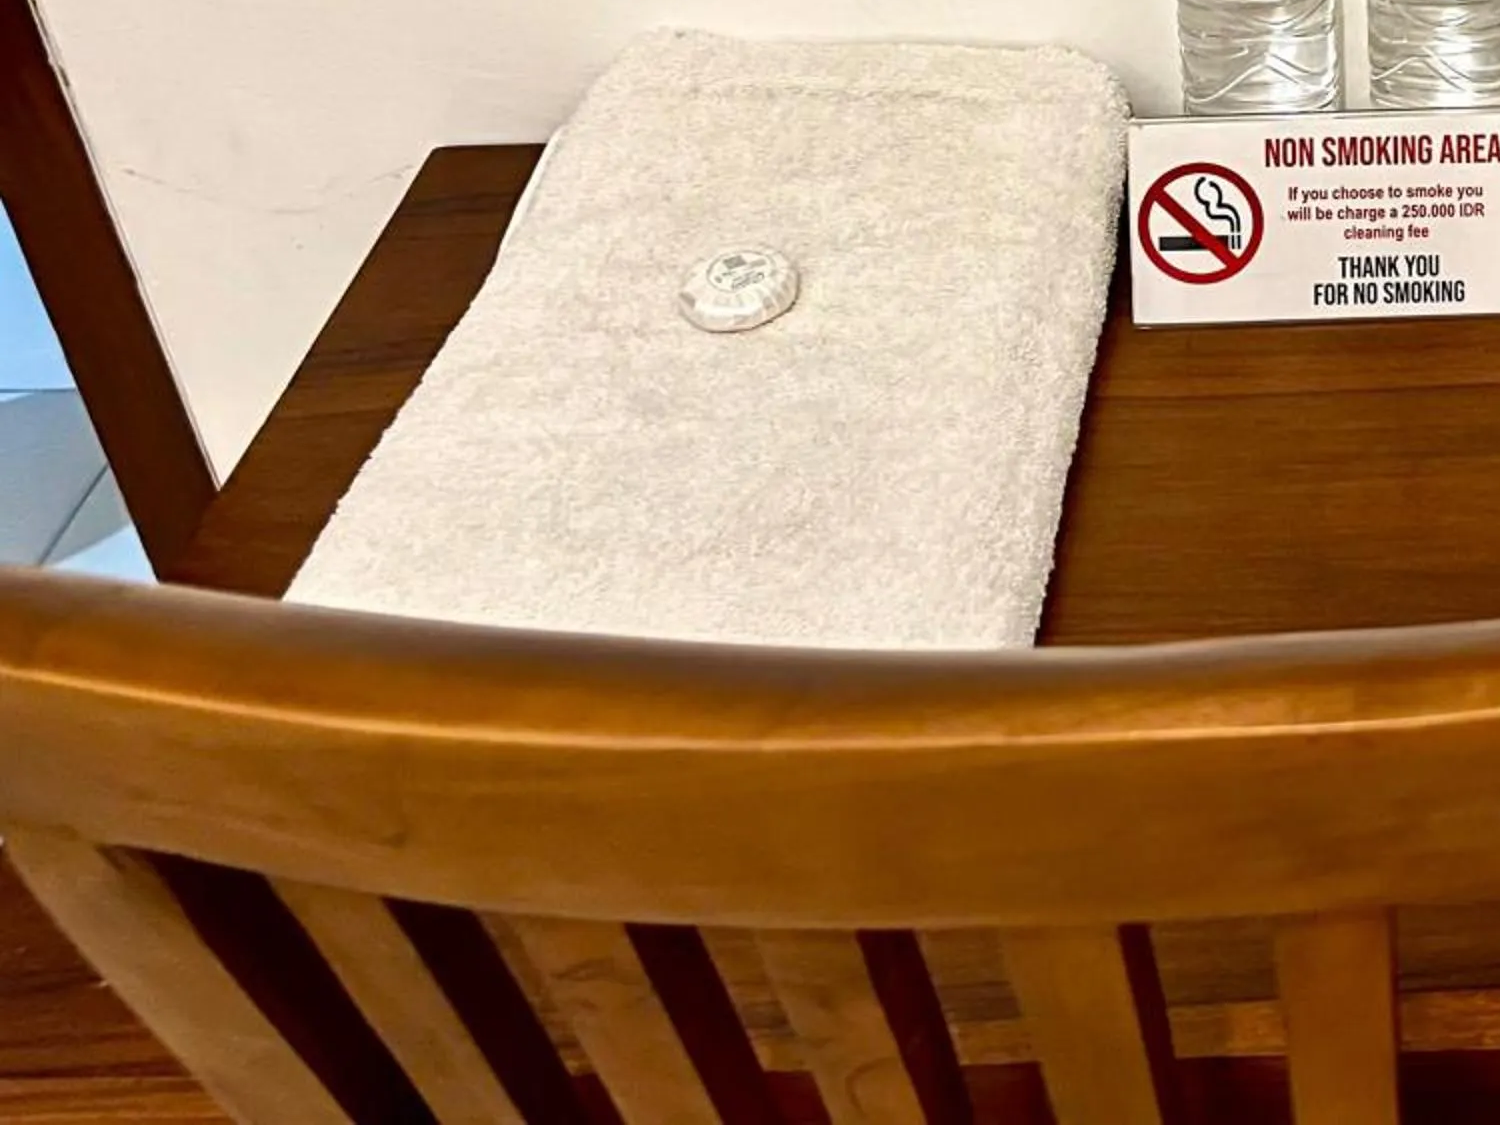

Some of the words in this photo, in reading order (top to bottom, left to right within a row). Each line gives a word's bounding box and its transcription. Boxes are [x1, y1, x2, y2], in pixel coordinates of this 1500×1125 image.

[1264, 136, 1314, 168] NON
[1321, 134, 1433, 167] SMOKING
[1288, 186, 1299, 201] If
[1301, 188, 1329, 204] you
[1331, 185, 1384, 200] choose
[1388, 185, 1403, 199] to
[1406, 183, 1453, 198] smoke
[1457, 186, 1484, 201] you
[1287, 206, 1312, 221] will
[1315, 206, 1333, 220] be
[1337, 206, 1386, 223] charge
[1389, 207, 1399, 218] a
[1401, 203, 1456, 218] 250.000
[1459, 202, 1486, 217] IDR
[1343, 225, 1405, 242] cleaning
[1407, 224, 1430, 238] fee
[1338, 255, 1400, 279] THANK
[1404, 254, 1440, 277] YOU
[1313, 283, 1349, 306] FOR
[1353, 282, 1379, 305] NO
[1383, 280, 1466, 304] SMOKING
